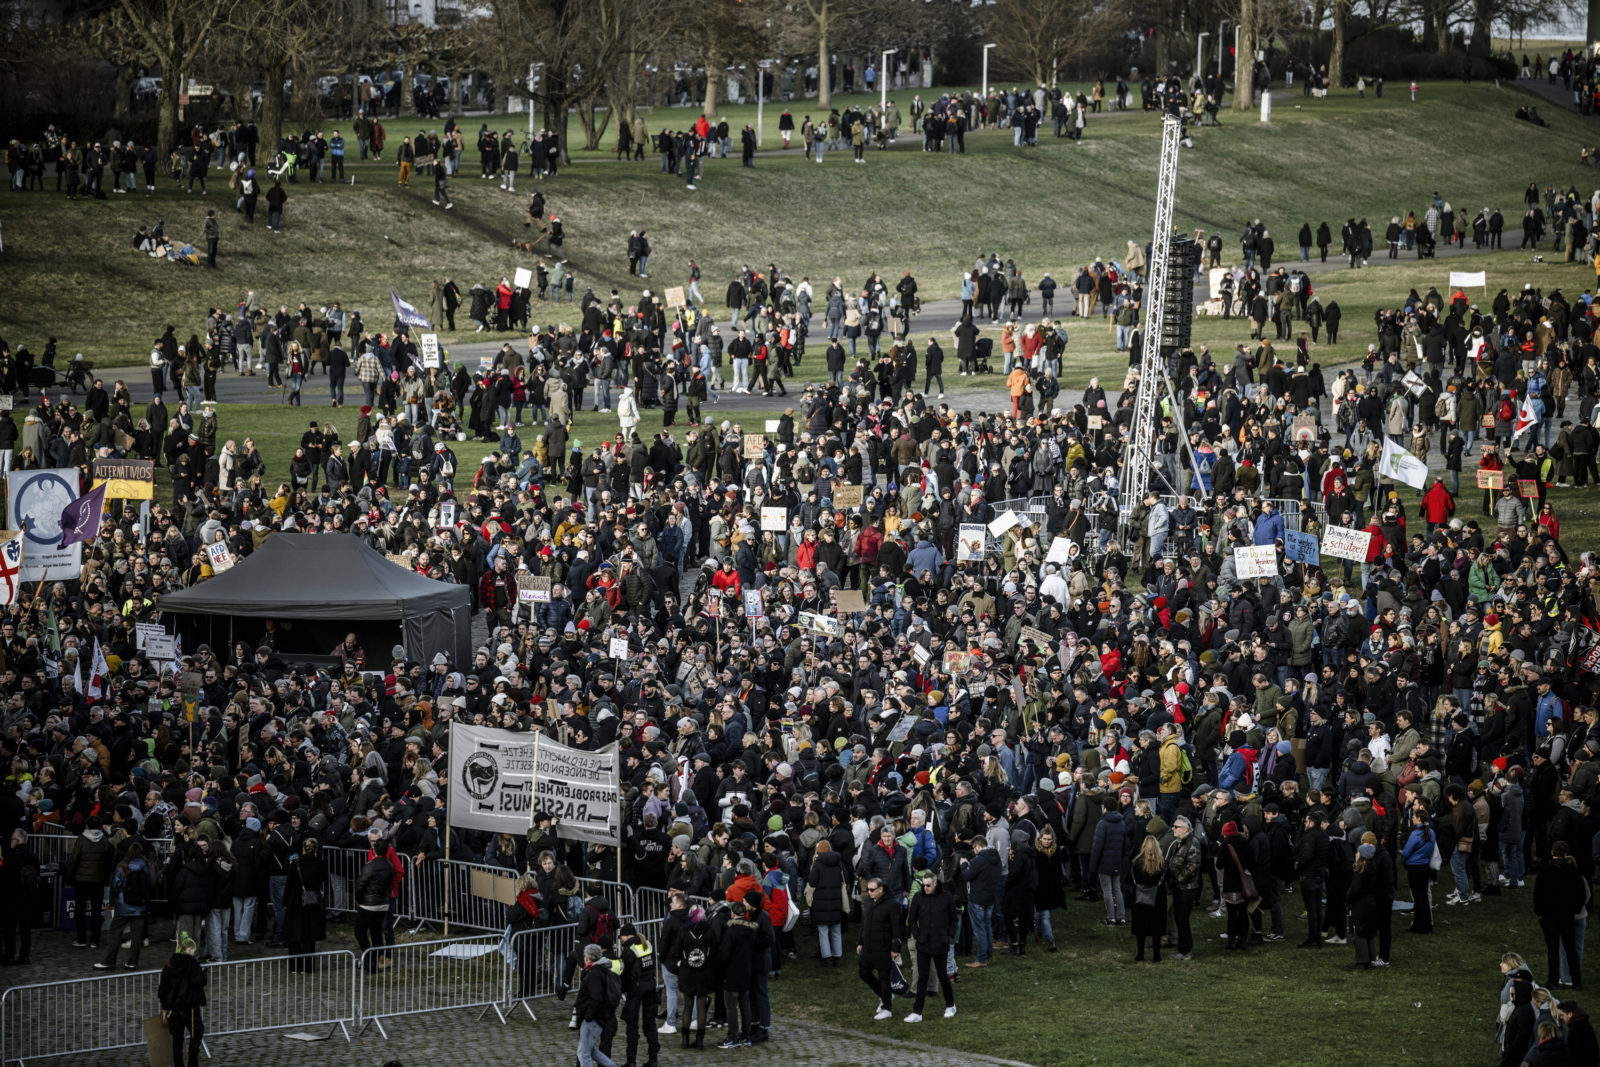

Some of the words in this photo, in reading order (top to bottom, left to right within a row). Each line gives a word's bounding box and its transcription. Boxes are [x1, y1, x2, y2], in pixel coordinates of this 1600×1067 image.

[94, 465, 152, 479] ALTERNATIVLOS
[1328, 526, 1364, 543] Demokratie
[211, 544, 225, 556] AFD
[1250, 548, 1259, 558] Du
[213, 552, 227, 565] NEE
